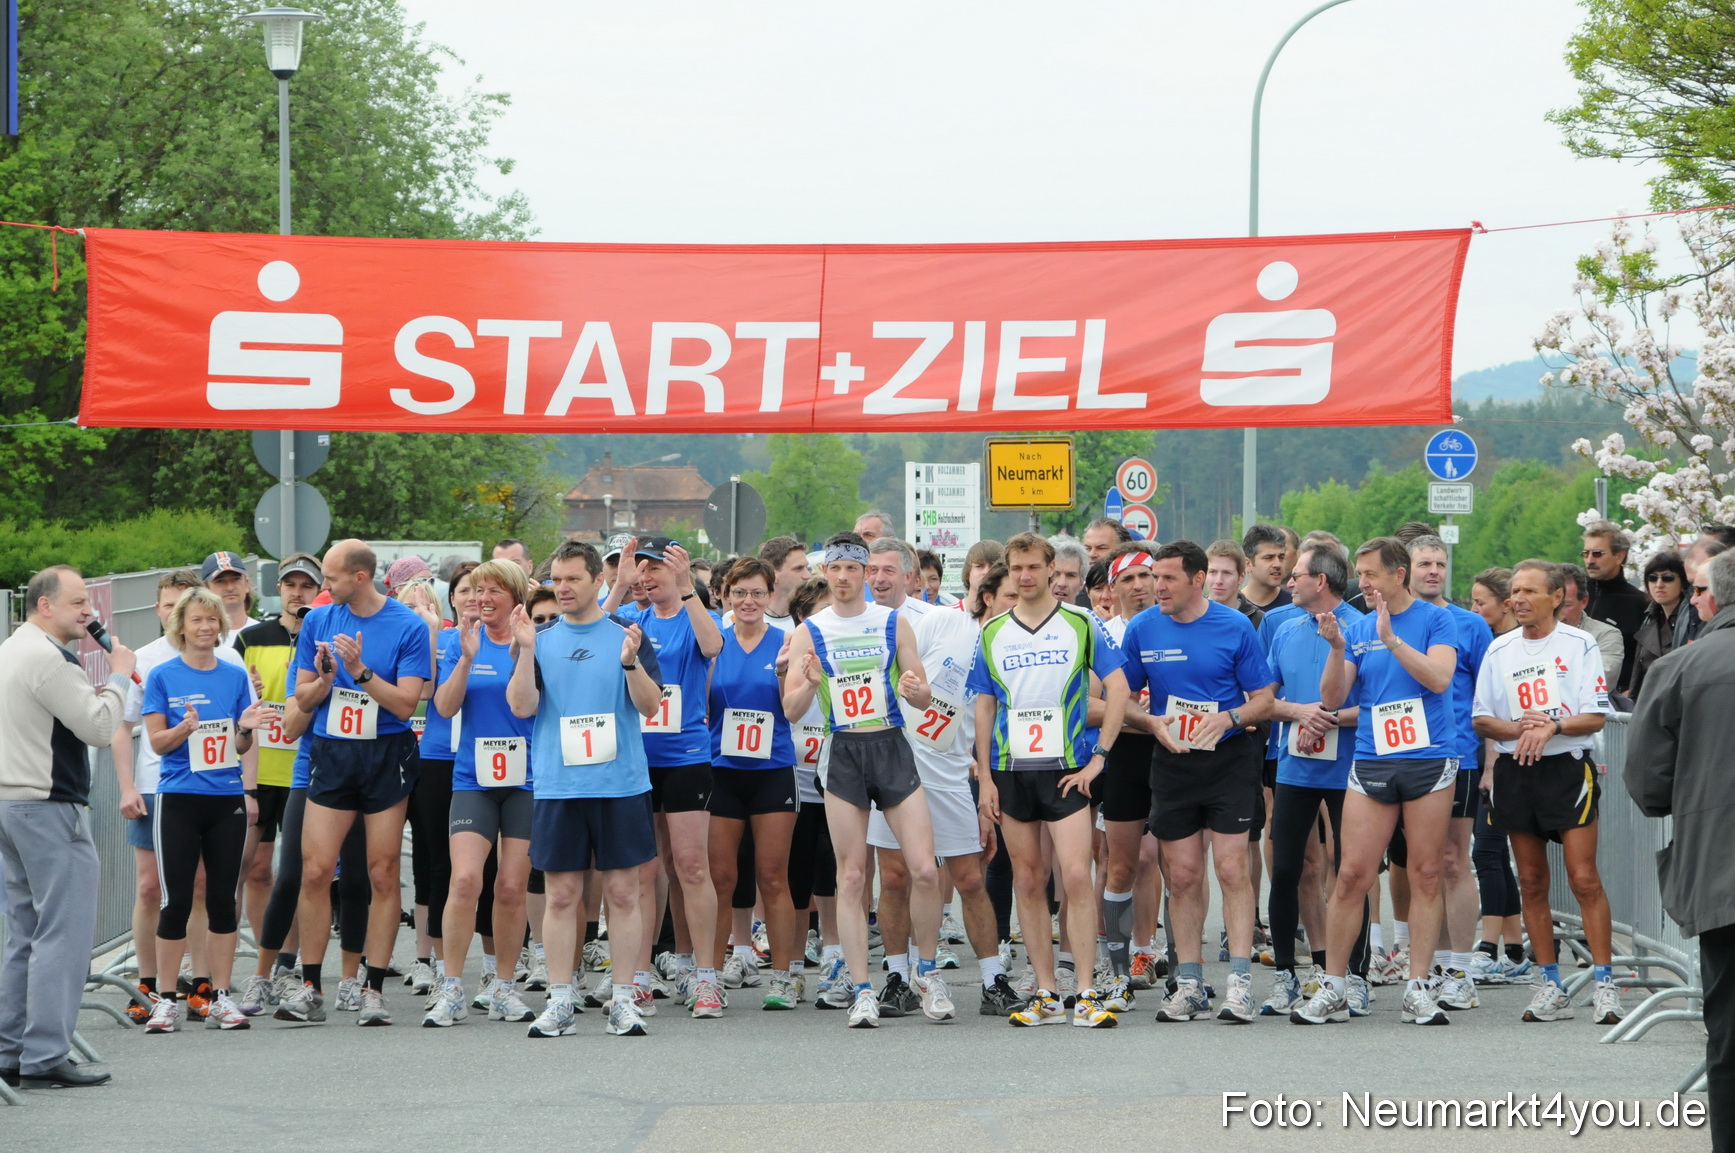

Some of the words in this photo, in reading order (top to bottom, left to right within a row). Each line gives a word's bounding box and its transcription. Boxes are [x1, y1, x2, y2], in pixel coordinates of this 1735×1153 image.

[1019, 452, 1042, 461] Nach
[997, 466, 1064, 481] Neumarkt
[1126, 471, 1148, 490] 60
[1020, 487, 1025, 495] 5
[1032, 487, 1044, 496] km
[922, 510, 937, 527] SHB
[833, 645, 885, 660] BOCK
[1003, 649, 1069, 672] BOCK
[836, 674, 861, 684] MEYER
[1512, 667, 1535, 678] MEYER
[339, 690, 360, 699] MEYER
[842, 686, 875, 718] 92
[930, 695, 948, 709] EYER
[1517, 677, 1549, 710] 86
[732, 710, 756, 718] MEYER
[1175, 700, 1199, 710] MEYER
[1378, 703, 1402, 714] MEYER
[340, 706, 363, 735] 61
[569, 716, 594, 725] MEYER
[916, 708, 952, 741] 27
[736, 723, 762, 752] 10
[1028, 724, 1044, 753] 2
[1384, 715, 1417, 748] 66
[203, 735, 228, 765] 67
[581, 729, 593, 758] 1
[804, 737, 825, 764] 2
[492, 752, 507, 781] 9
